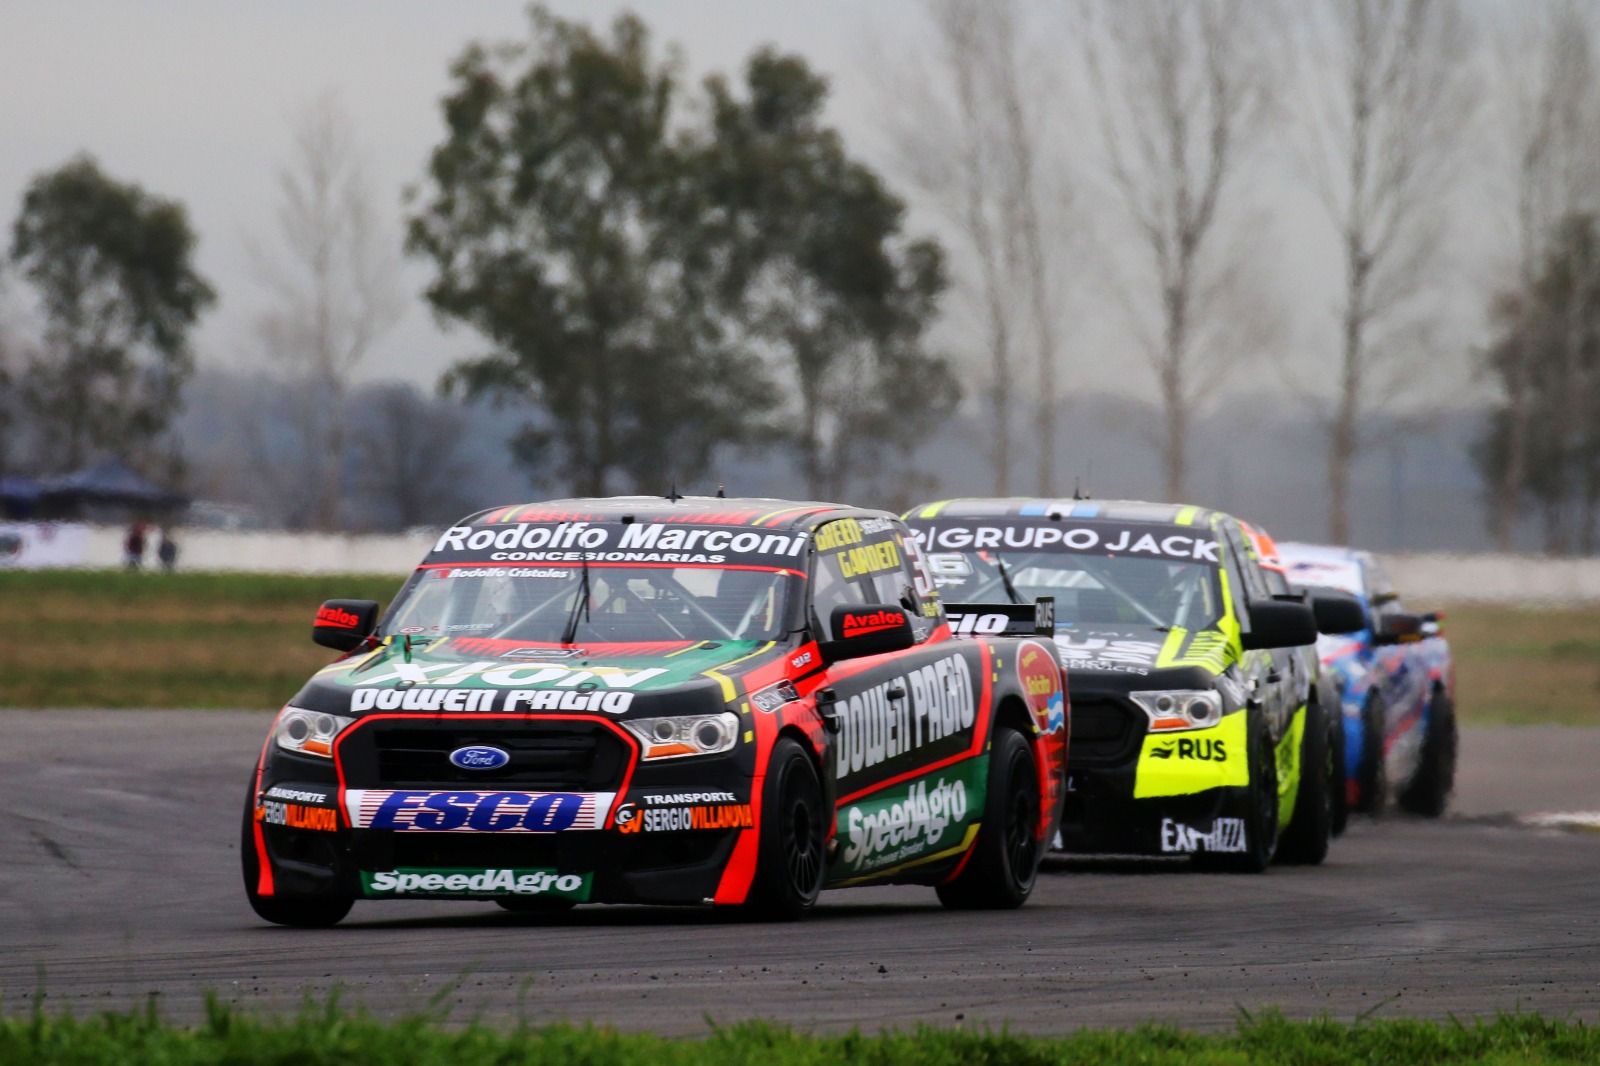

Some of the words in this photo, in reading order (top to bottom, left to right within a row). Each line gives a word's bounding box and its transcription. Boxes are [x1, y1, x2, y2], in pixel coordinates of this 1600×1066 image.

[434, 523, 608, 551] Rodolfo
[617, 524, 806, 557] Marconi
[937, 527, 1099, 550] GRUPO
[1105, 531, 1220, 562] JACK
[490, 551, 726, 564] CONCESIONARIAS
[837, 540, 900, 578] GARDEN
[903, 536, 938, 598] 3
[448, 568, 506, 578] Rodolfo
[507, 568, 569, 578] Cristales
[843, 611, 905, 629] Avalos
[1035, 602, 1054, 628] RUS
[350, 687, 498, 713] DOWEN
[502, 688, 635, 714] PAGIO
[834, 675, 911, 779] DOWEN
[907, 653, 974, 748] PAGIO
[462, 750, 496, 765] Ford
[1178, 738, 1228, 762] RUS
[368, 792, 584, 831] ESCO
[643, 792, 736, 805] TRANSPORTE
[843, 777, 967, 872] SpeedAgro
[370, 869, 583, 895] SpeedAgro
